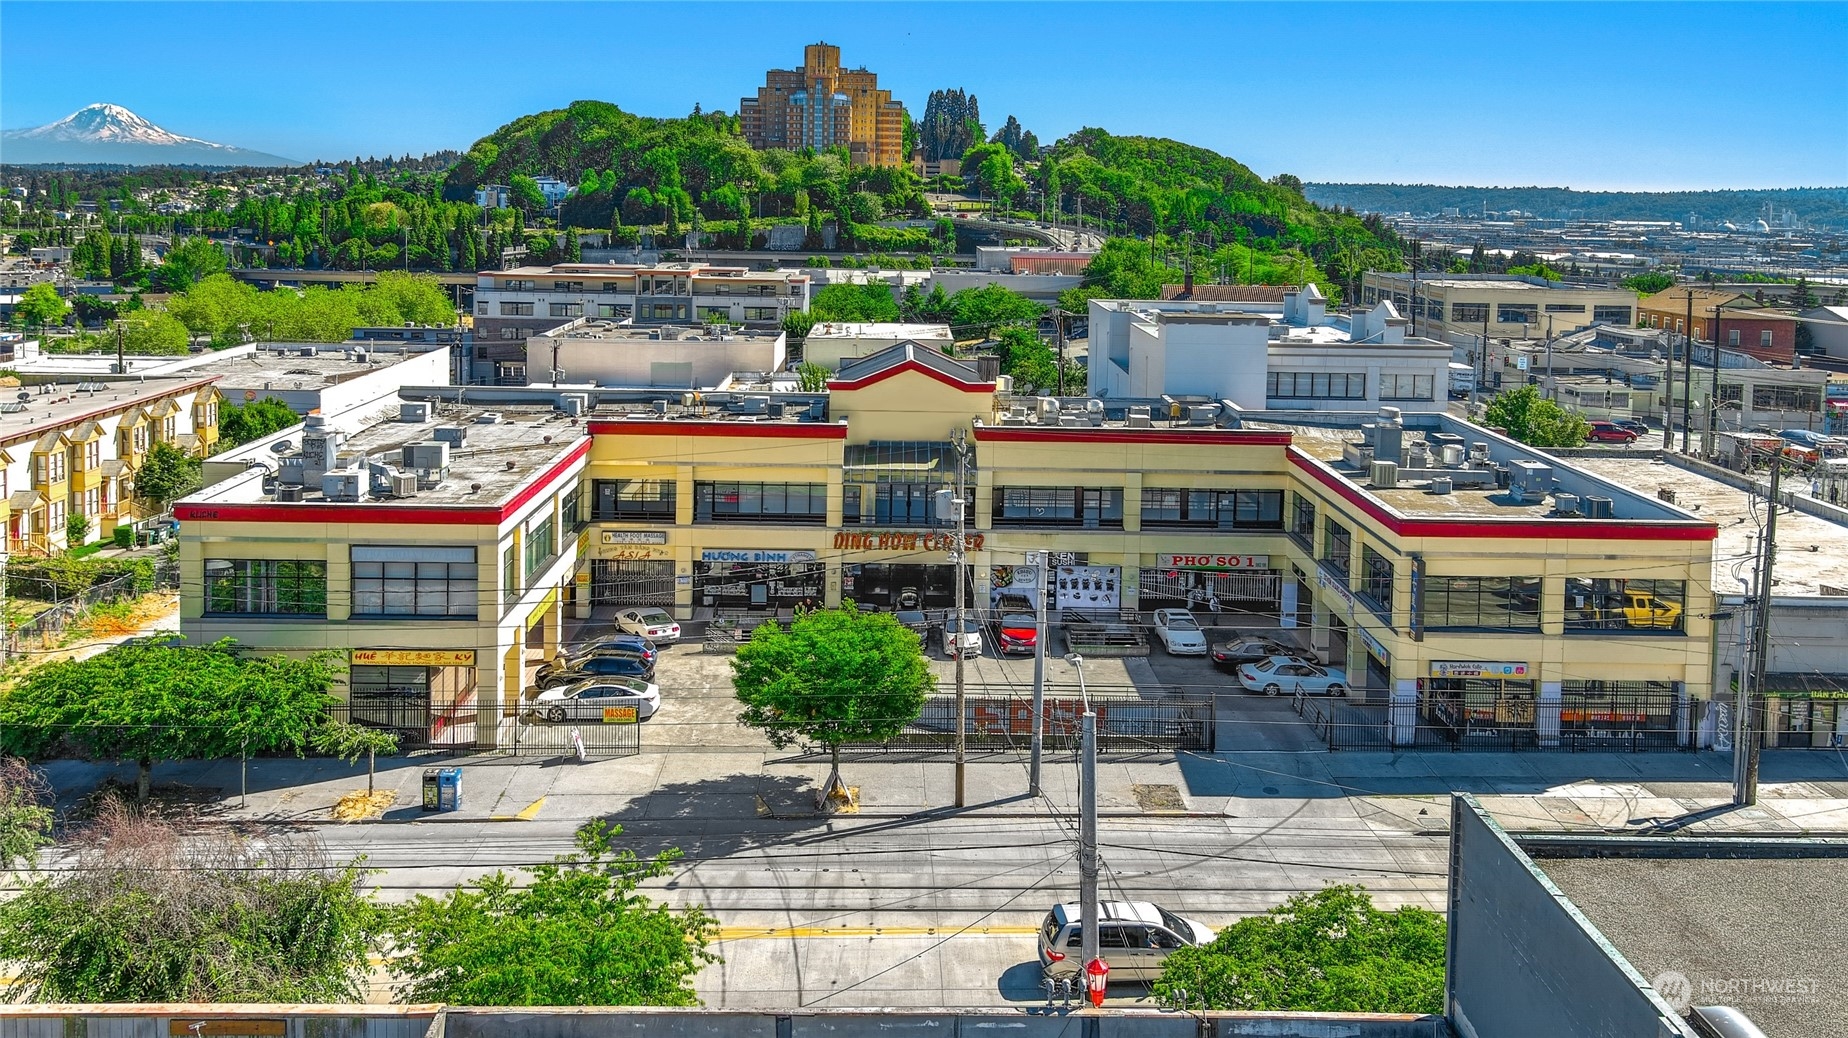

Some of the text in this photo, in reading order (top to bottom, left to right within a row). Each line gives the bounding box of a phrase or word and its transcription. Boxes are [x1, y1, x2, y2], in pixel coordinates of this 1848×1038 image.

[834, 532, 873, 550] DING
[613, 551, 651, 560] ASIA
[1246, 557, 1254, 567] 1
[604, 708, 635, 718] MASSAGE
